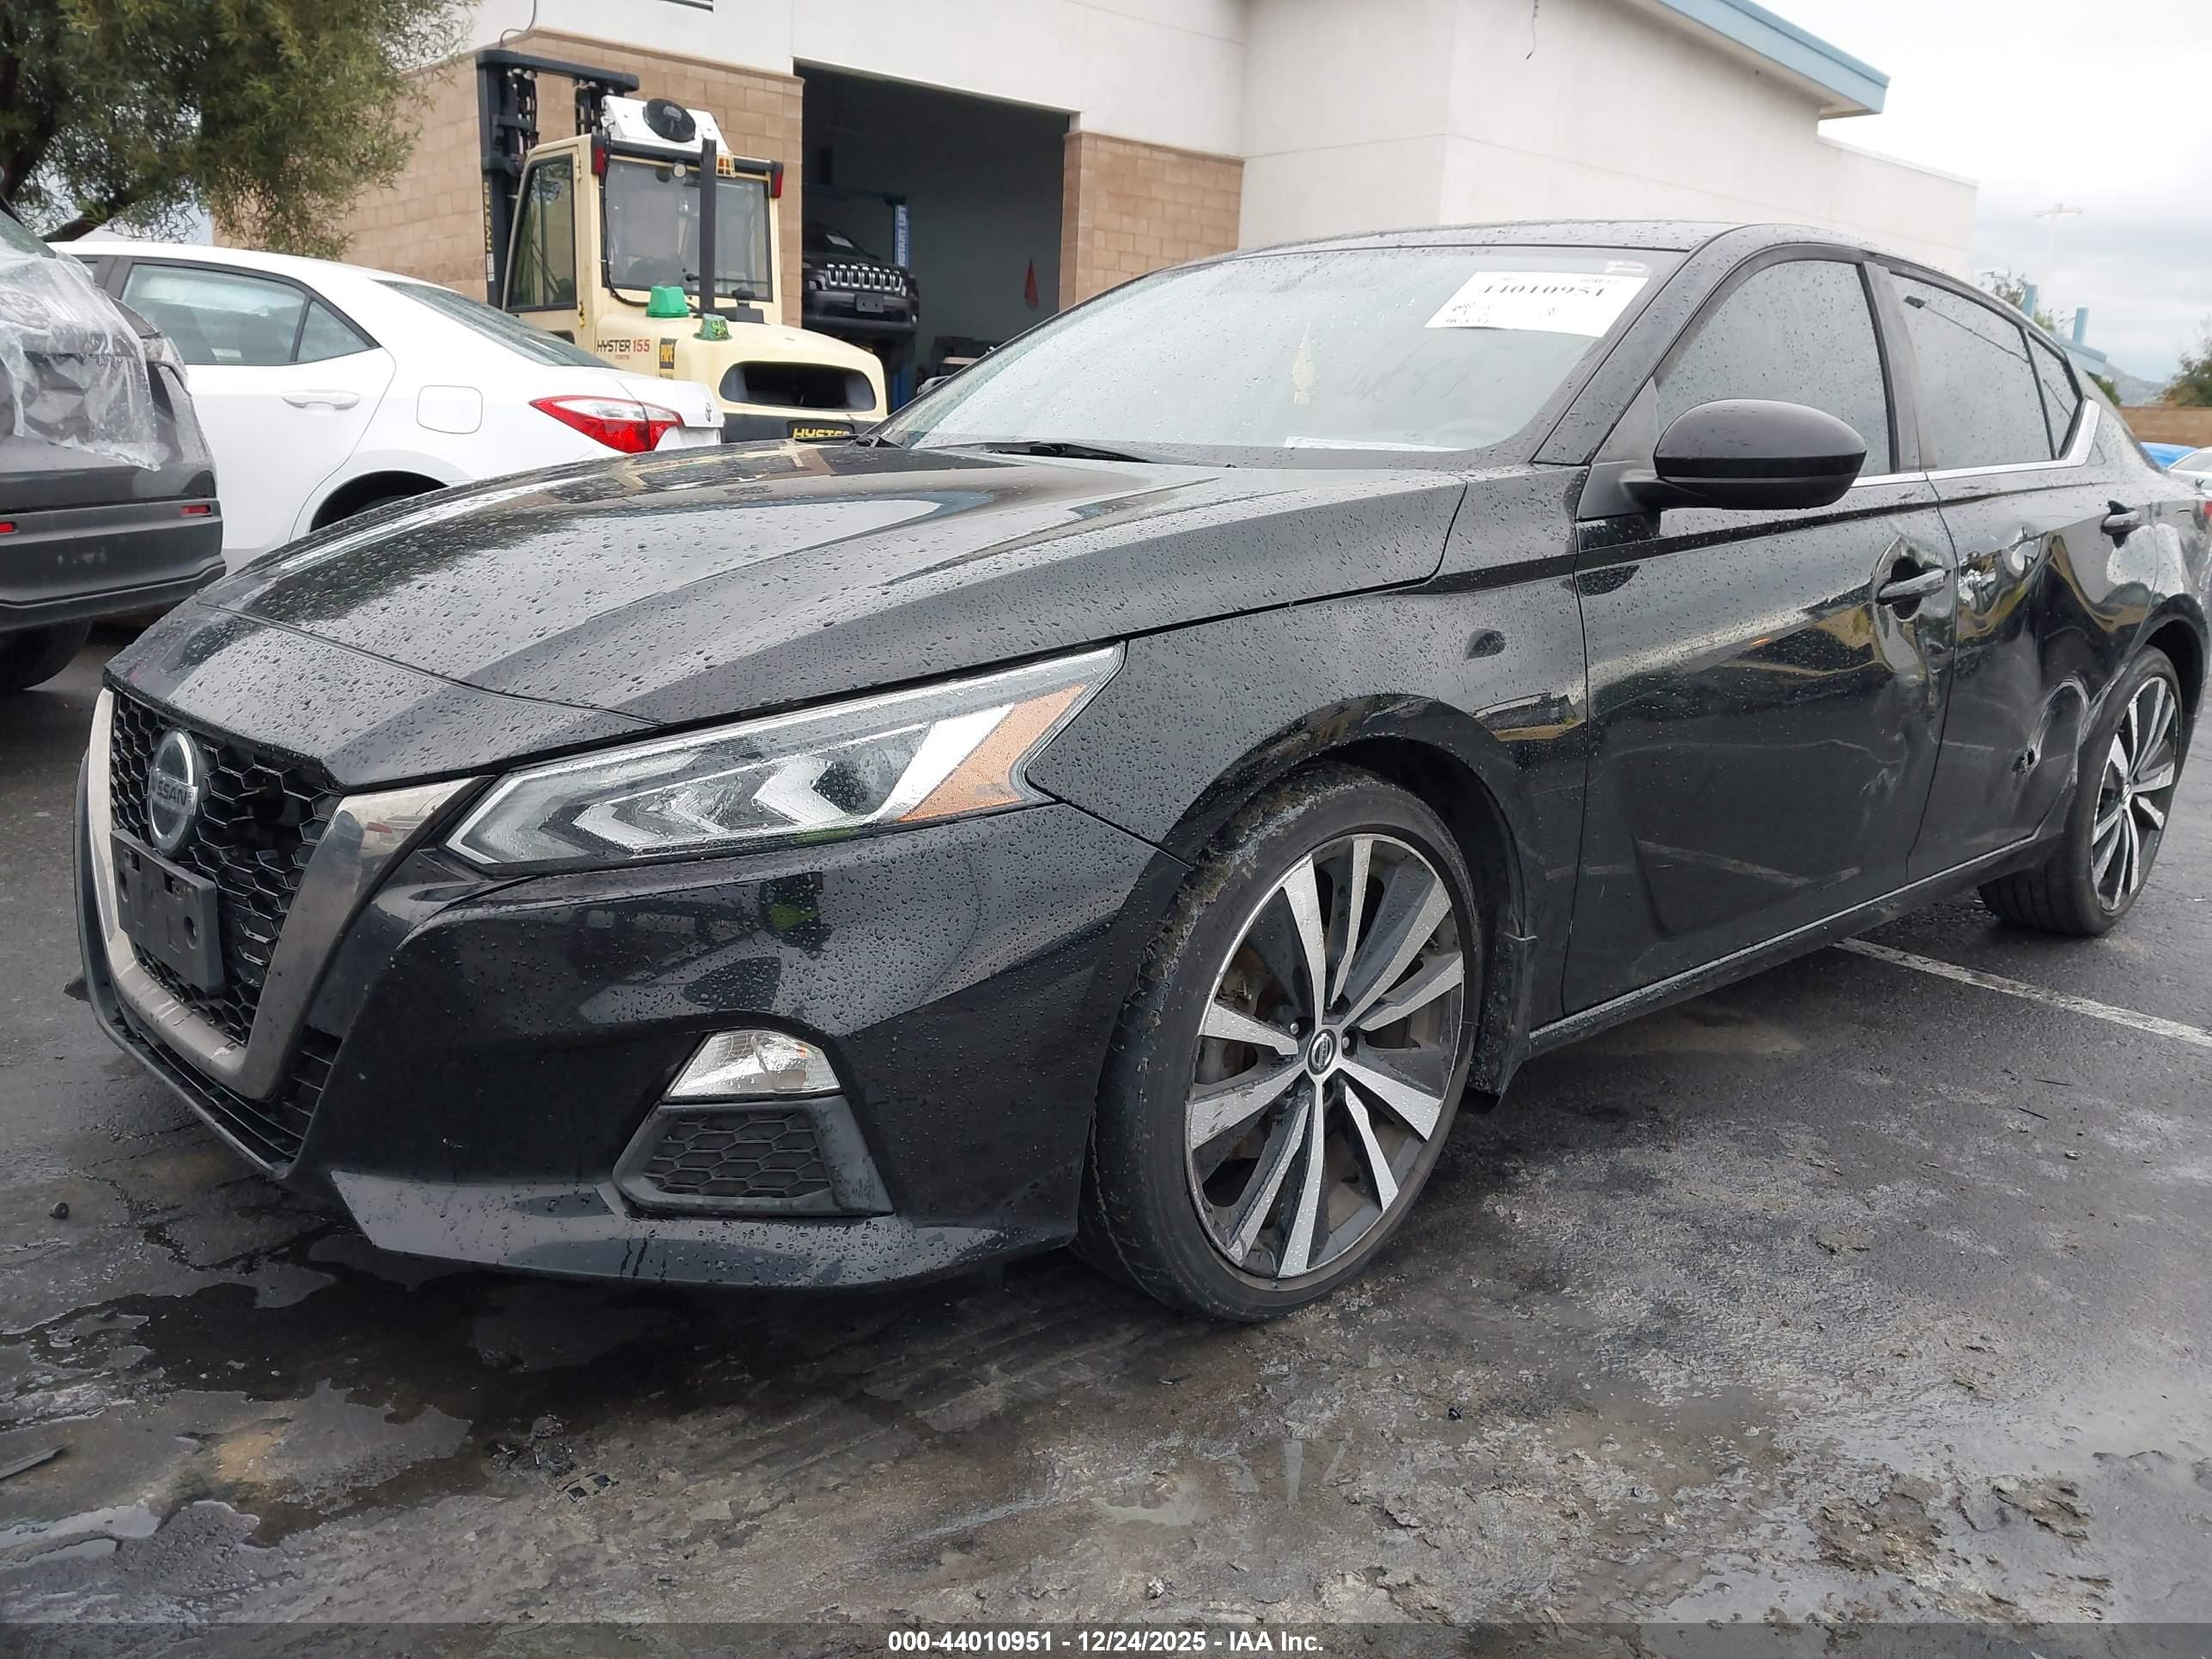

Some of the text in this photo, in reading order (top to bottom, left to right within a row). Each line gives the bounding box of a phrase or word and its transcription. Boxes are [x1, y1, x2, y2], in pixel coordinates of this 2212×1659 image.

[898, 228, 907, 267] ROTARY
[596, 339, 631, 353] HYSTER
[633, 338, 650, 353] 155
